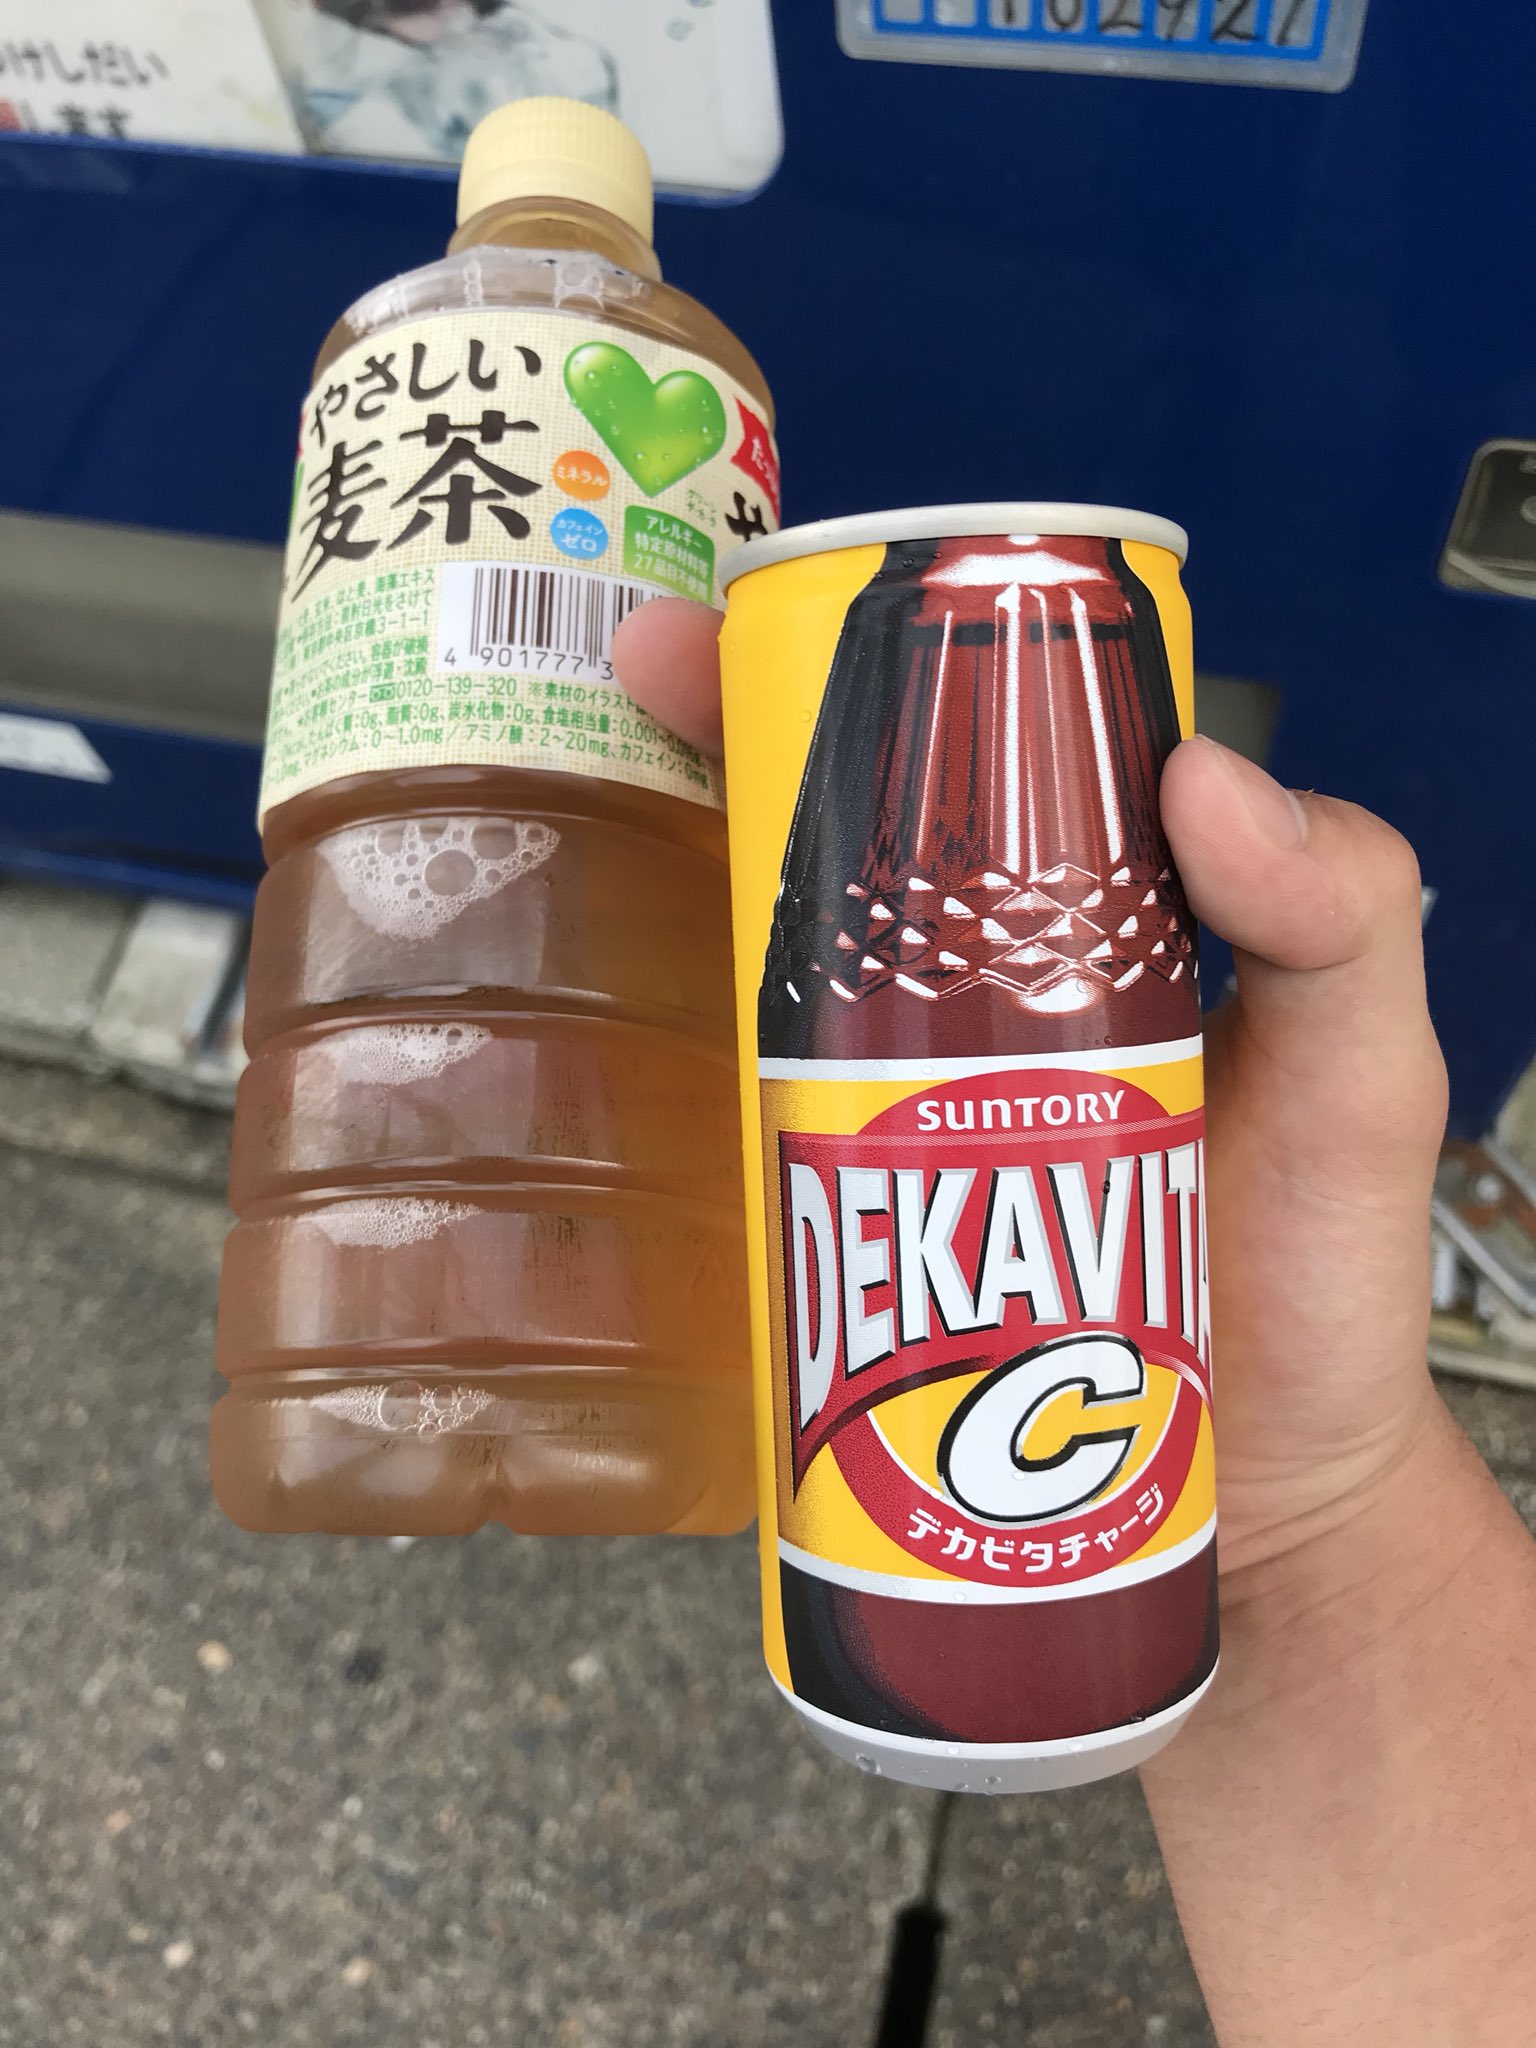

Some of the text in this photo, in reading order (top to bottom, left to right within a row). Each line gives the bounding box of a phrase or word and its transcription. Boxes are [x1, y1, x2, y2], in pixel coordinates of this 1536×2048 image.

[0, 40, 171, 87] けしだい
[310, 339, 543, 446] やさしい
[556, 465, 608, 487] ミネラル
[291, 409, 543, 604] 麦茶
[555, 518, 604, 536] カフェイン
[560, 532, 598, 553] ゼロ
[645, 515, 703, 549] アレルギー
[444, 648, 457, 667] 4
[480, 647, 585, 675] 901777
[397, 676, 518, 699] 0120-139-320
[917, 1090, 1125, 1132] SUNTORY
[937, 1331, 1146, 1523] C
[907, 1482, 1166, 1574] デカビタチャージ
